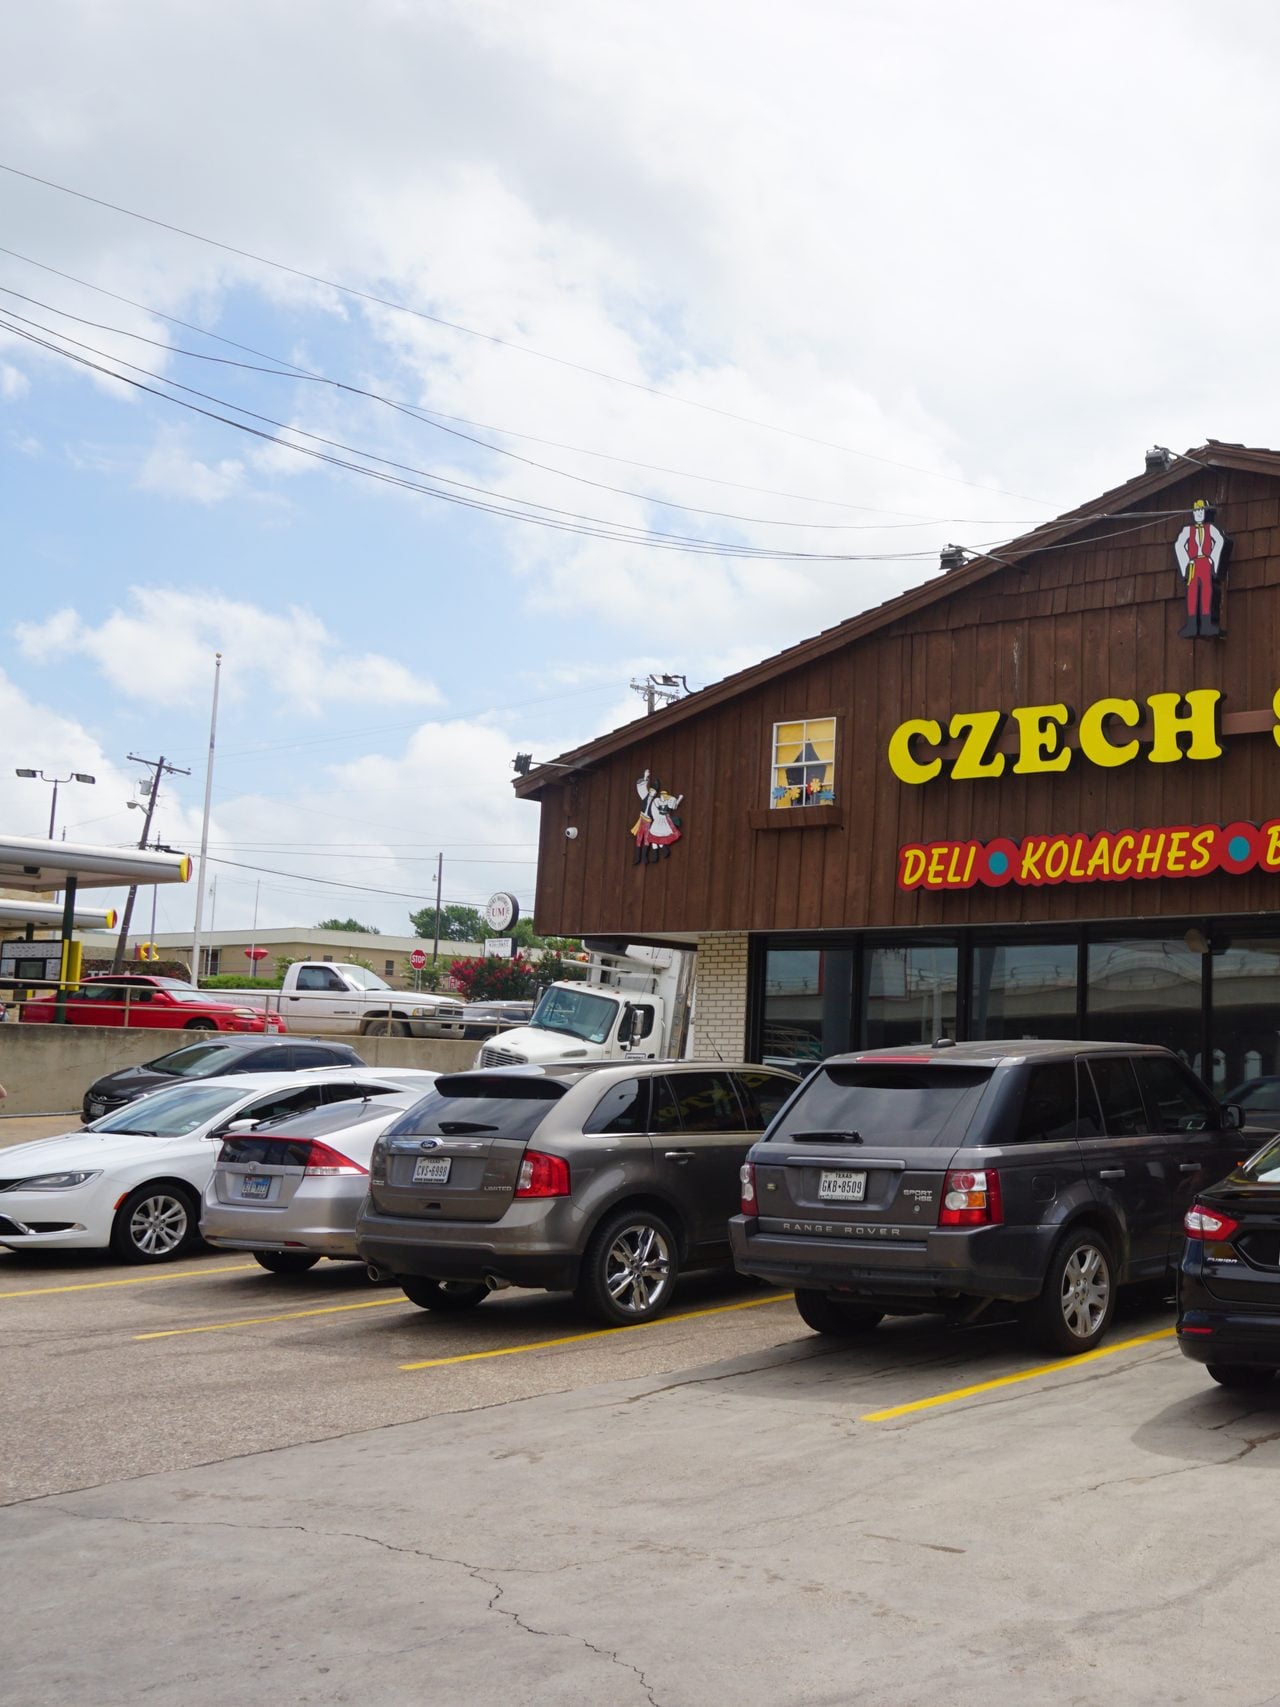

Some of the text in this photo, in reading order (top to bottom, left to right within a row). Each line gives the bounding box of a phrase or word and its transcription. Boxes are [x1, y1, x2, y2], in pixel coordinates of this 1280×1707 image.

[887, 689, 1223, 785] CZECH
[903, 845, 977, 885] DELI
[1020, 829, 1215, 880] KOLACHES
[411, 955, 426, 964] STOP
[783, 1222, 900, 1236] RANGE ROVER
